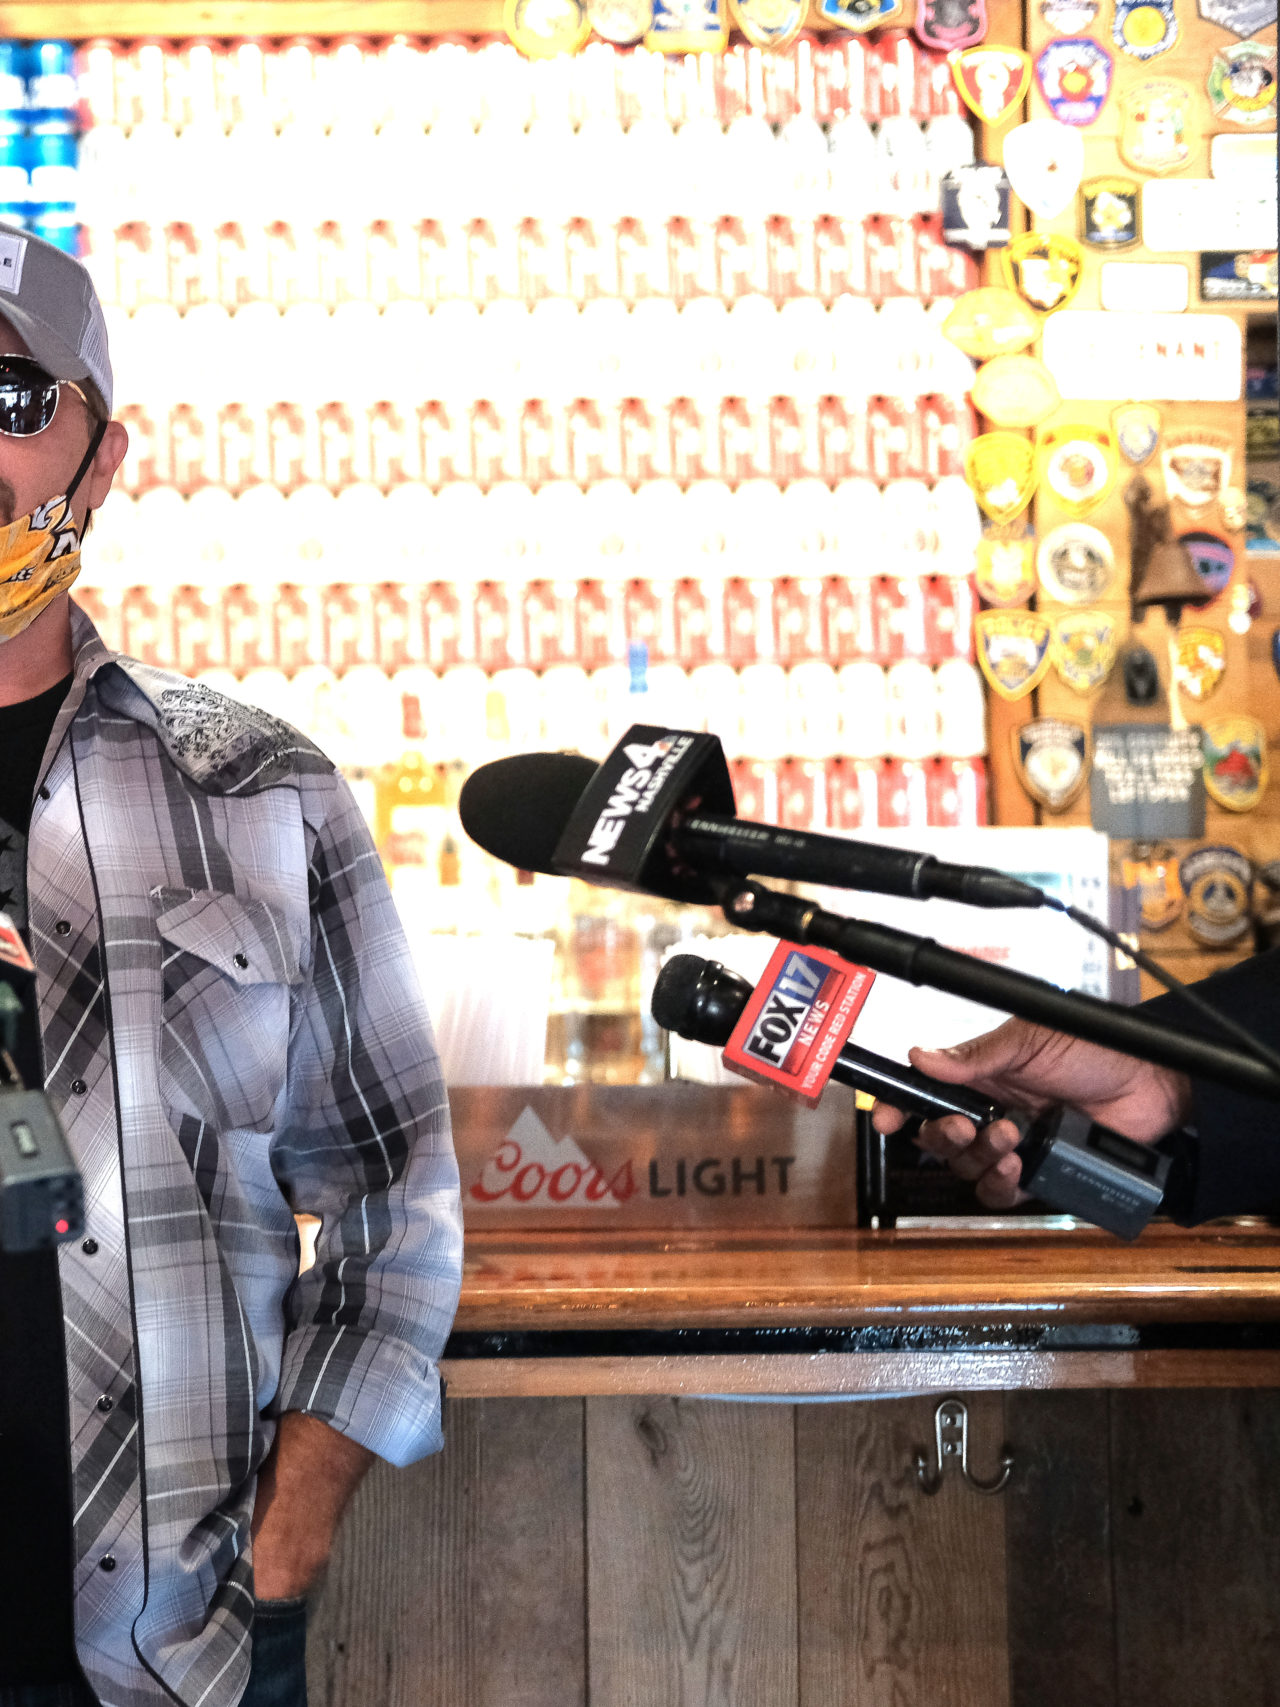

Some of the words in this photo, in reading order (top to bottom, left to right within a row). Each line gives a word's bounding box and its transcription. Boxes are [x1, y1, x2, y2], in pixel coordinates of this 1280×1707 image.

[634, 735, 695, 813] NASHVILLE
[797, 999, 830, 1047] NEWS
[801, 1062, 823, 1089] YOUR
[818, 1034, 836, 1063] CODE
[829, 1013, 847, 1036] RED
[839, 971, 868, 1016] STATION
[470, 1140, 640, 1202] Coors
[648, 1156, 797, 1198] LIGHT
